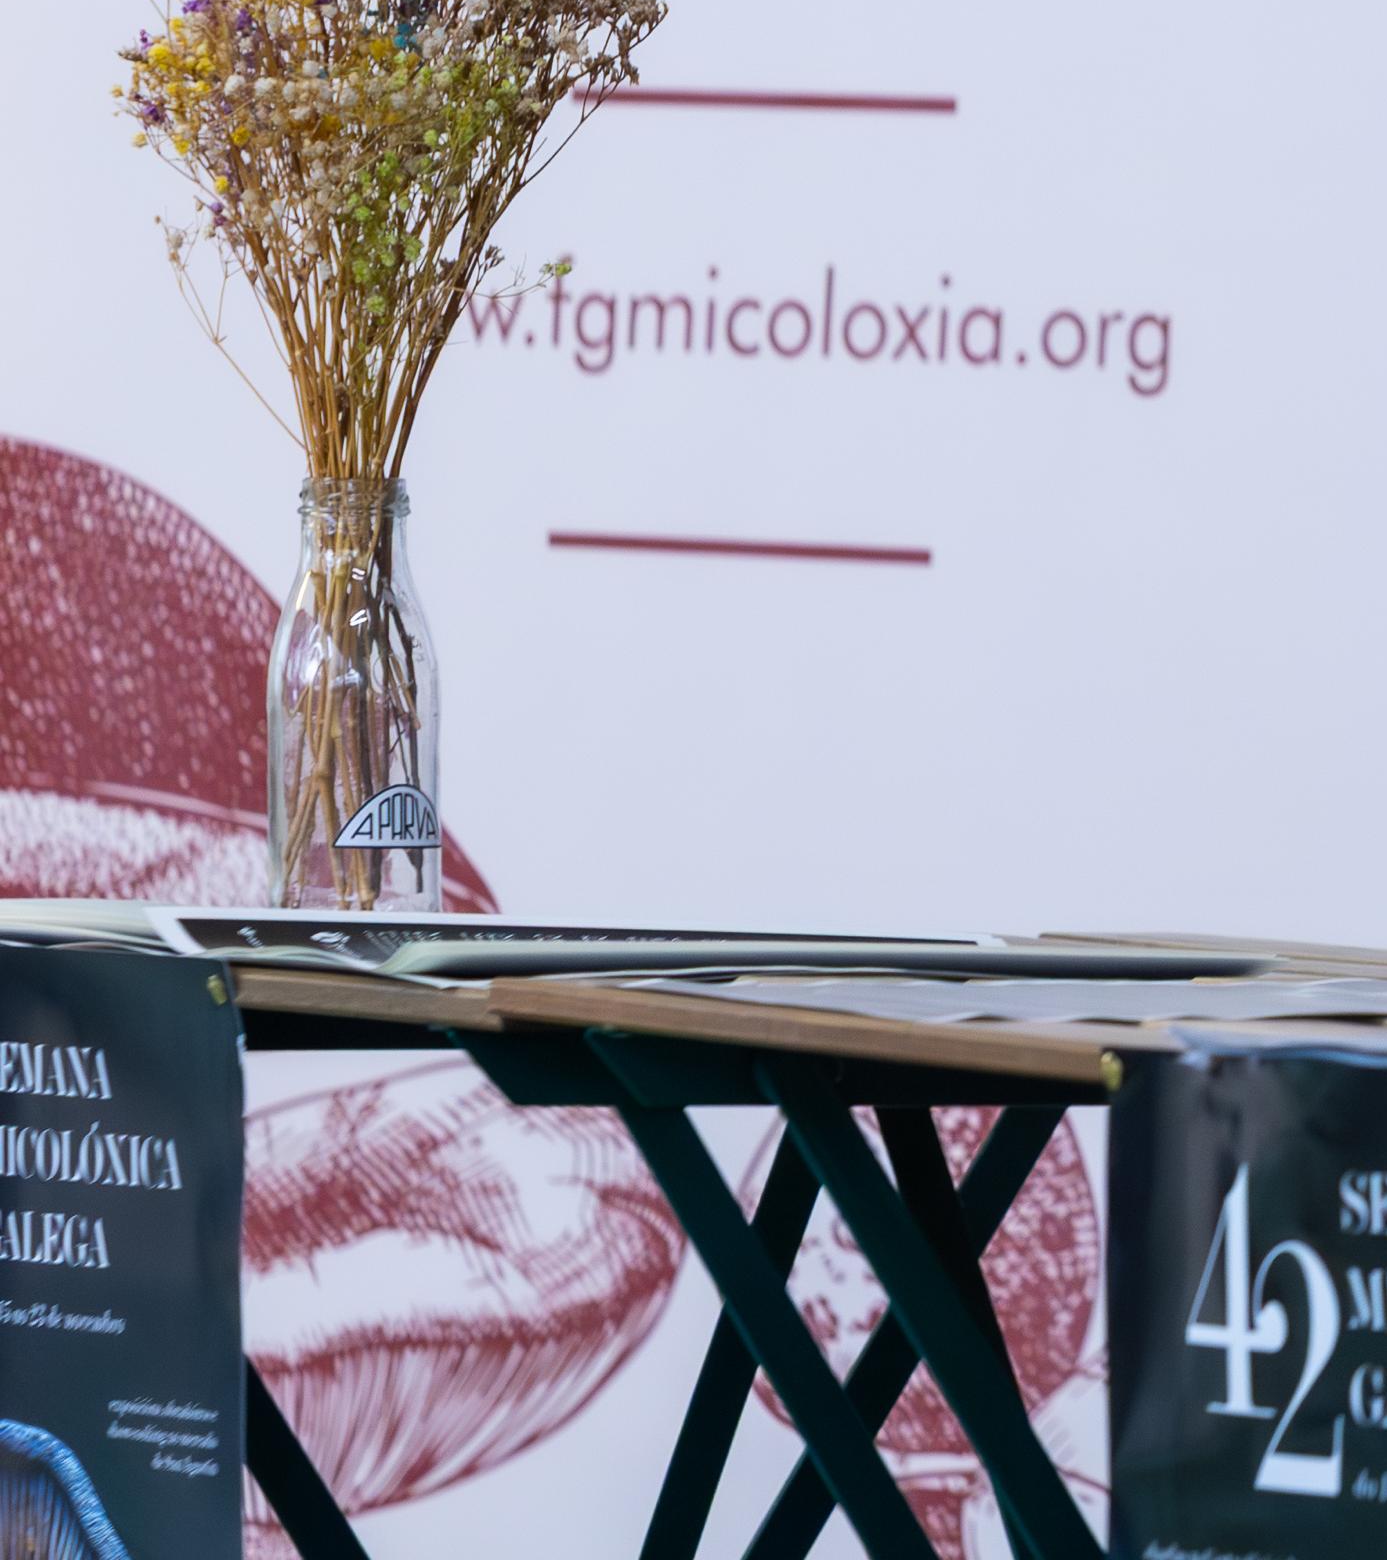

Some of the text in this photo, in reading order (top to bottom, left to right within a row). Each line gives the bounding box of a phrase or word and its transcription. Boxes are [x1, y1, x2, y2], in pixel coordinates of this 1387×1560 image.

[464, 252, 1173, 398] w.fgmicoloxia.org
[0, 1040, 113, 1101] EMANA
[0, 1210, 111, 1269] ALEGA
[1185, 1162, 1345, 1498] 42
